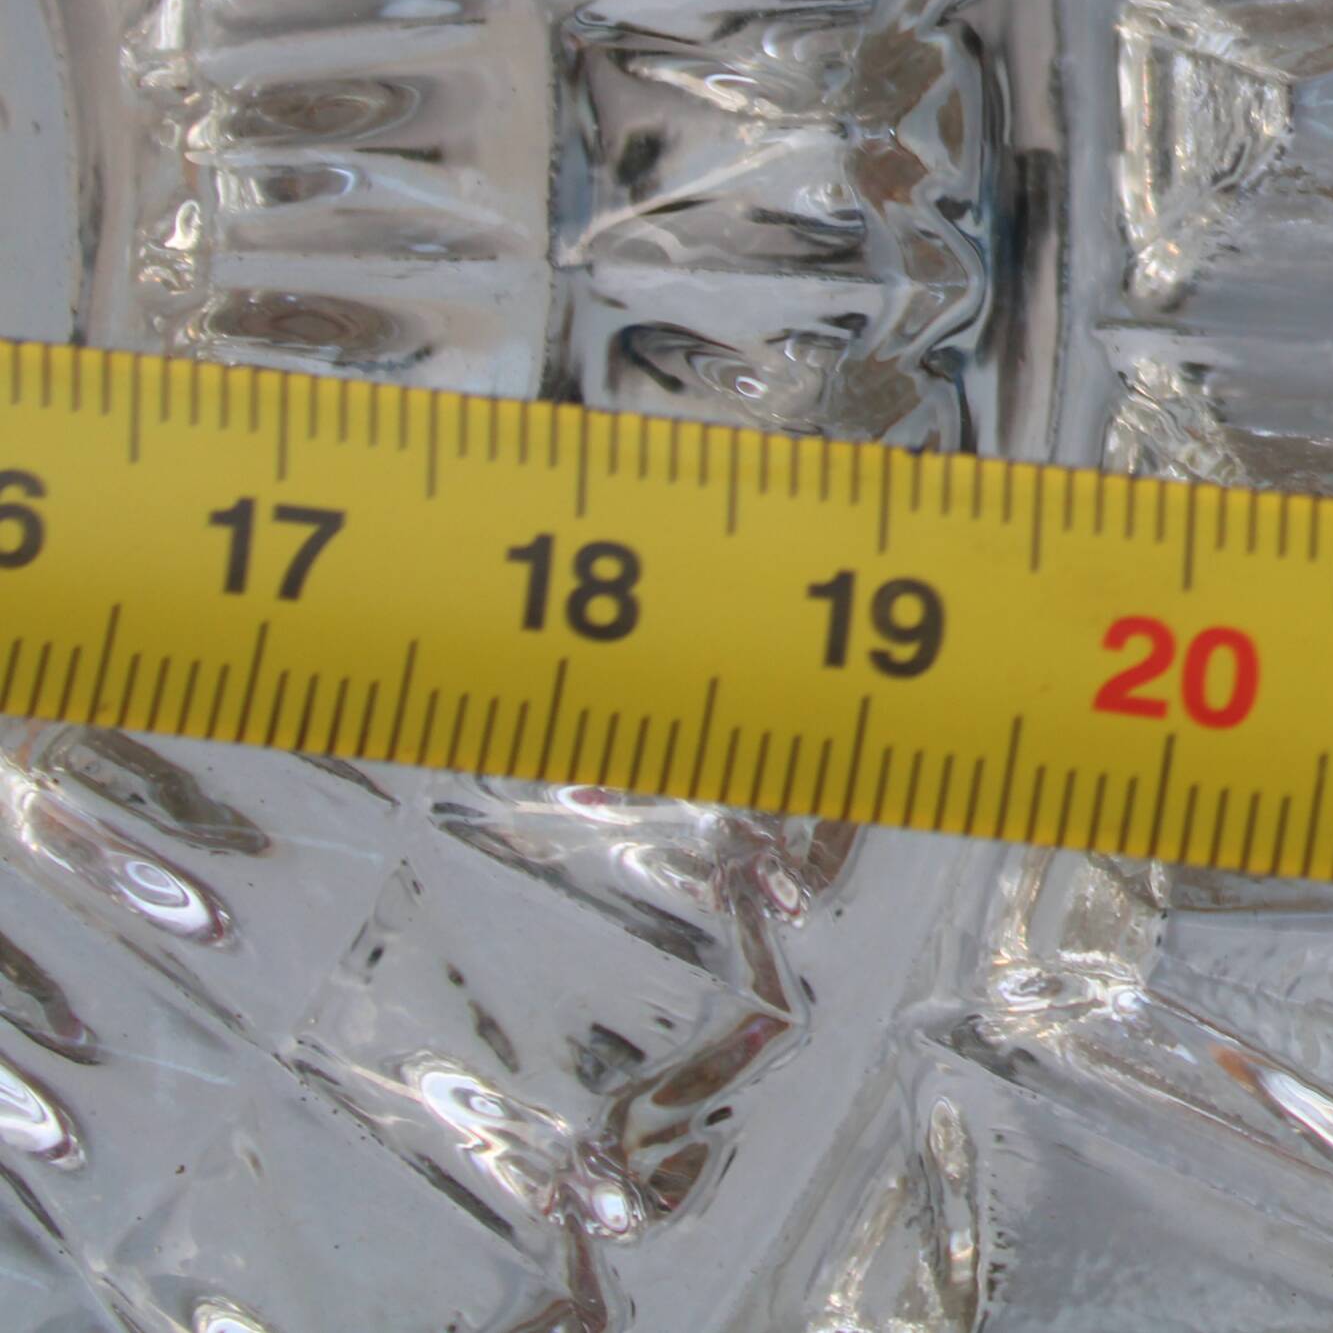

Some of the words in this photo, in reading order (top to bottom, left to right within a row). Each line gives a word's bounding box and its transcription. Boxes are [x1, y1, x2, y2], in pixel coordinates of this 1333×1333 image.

[208, 496, 346, 602] 17
[506, 533, 641, 643] 18
[807, 570, 946, 679] 19
[1092, 615, 1262, 731] 20
